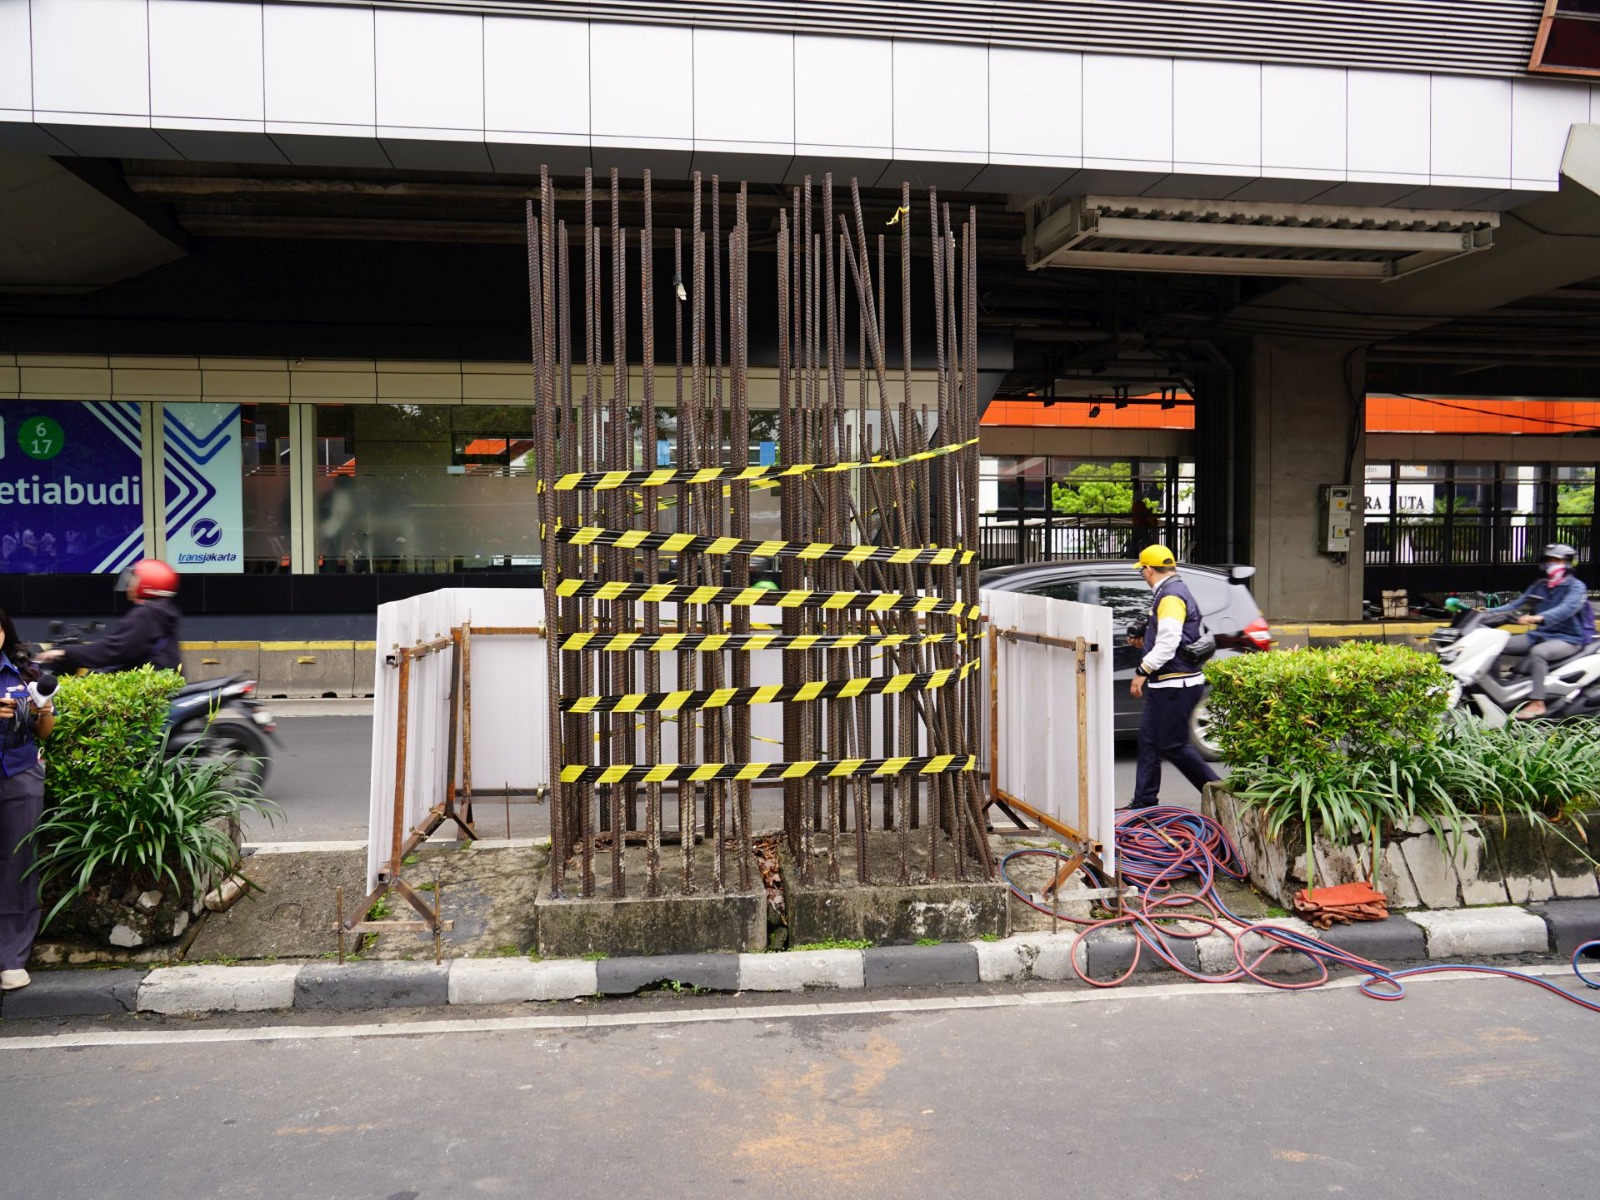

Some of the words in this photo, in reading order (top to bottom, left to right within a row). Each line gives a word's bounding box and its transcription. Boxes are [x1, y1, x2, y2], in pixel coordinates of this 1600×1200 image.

[36, 422, 47, 437] 6
[31, 439, 52, 454] 17
[0, 474, 140, 505] etiabudi
[1389, 496, 1425, 510] UTA
[178, 552, 237, 565] transjakarta
